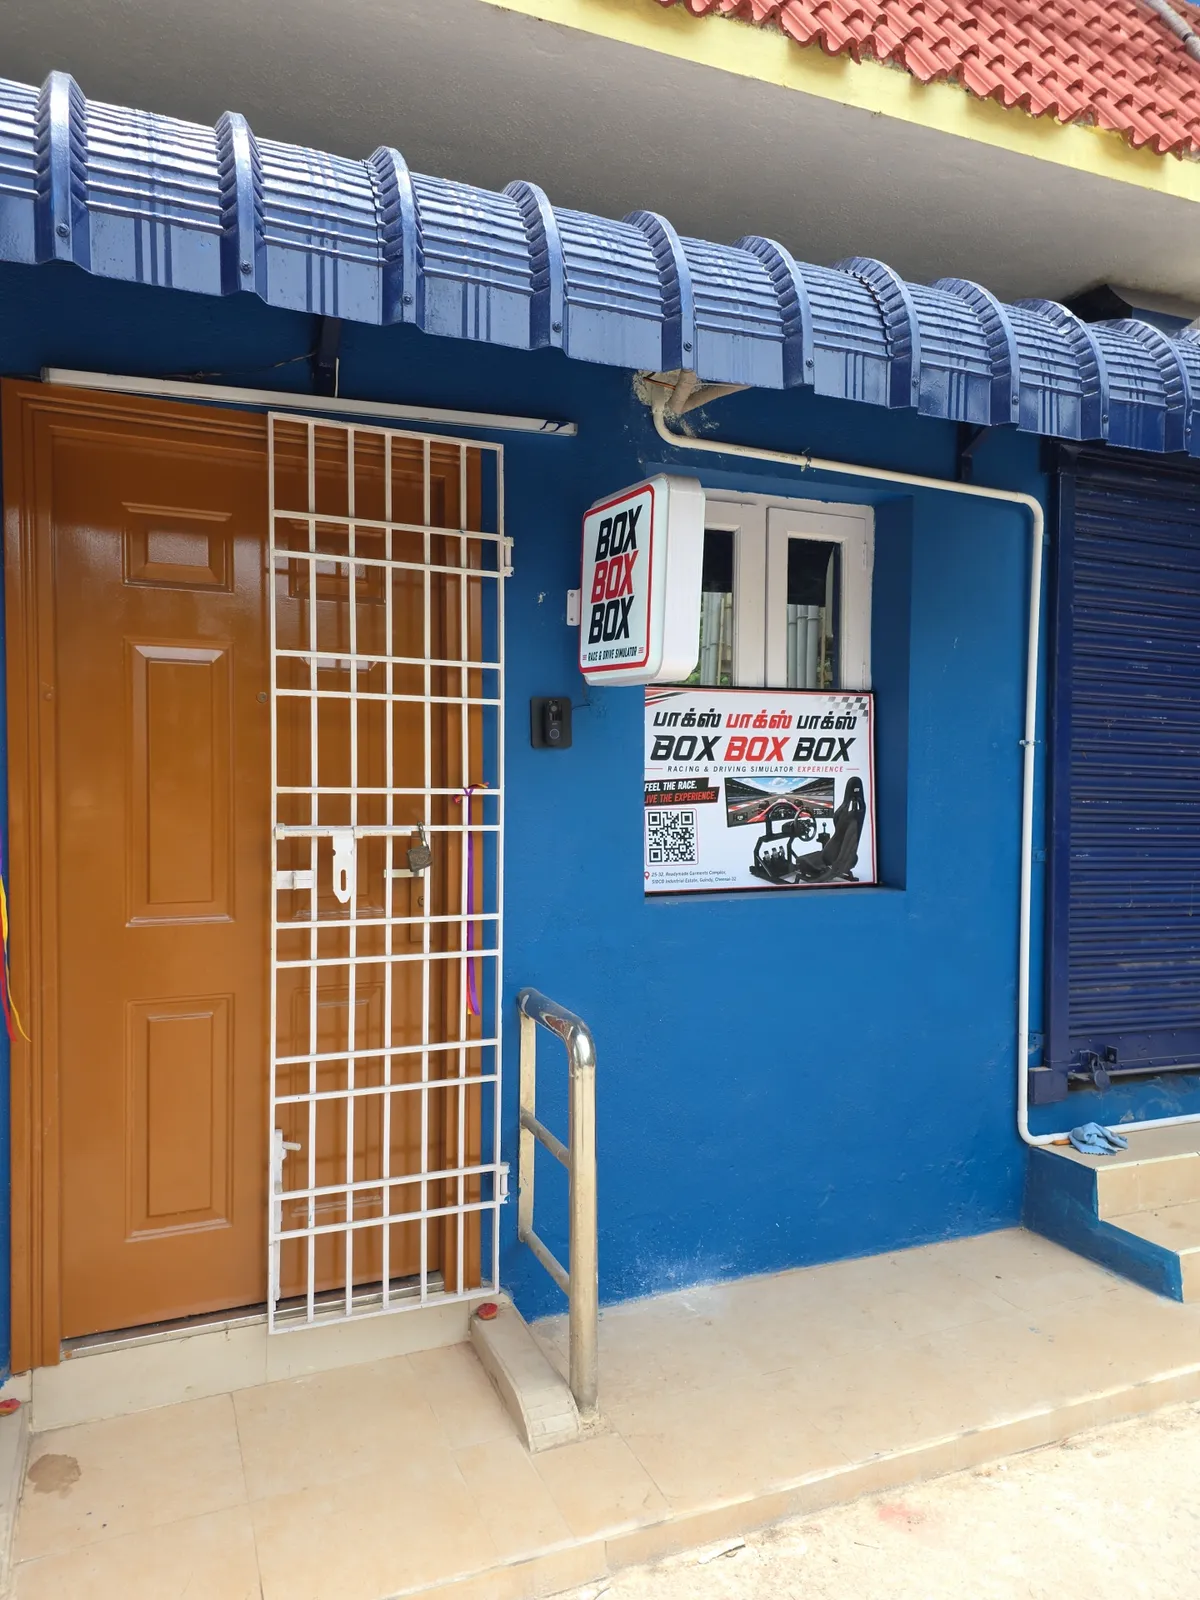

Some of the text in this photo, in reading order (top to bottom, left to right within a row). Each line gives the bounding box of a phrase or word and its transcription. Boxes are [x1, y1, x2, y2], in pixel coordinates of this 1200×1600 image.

[595, 504, 643, 562] BOX
[591, 550, 639, 604] BOX
[588, 596, 635, 644] BOX
[588, 651, 598, 661] RACE
[603, 649, 615, 660] DRIVE
[615, 646, 638, 658] SIMULATOR
[653, 708, 857, 730] பாக்ஸ் பாக்ஸ் பாக்ஸ்
[650, 735, 857, 762] BOX BOX BOX
[667, 765, 844, 773] RACING & DRIVING SIMULATOR EXPERIENCE
[644, 781, 697, 792] FEEL THE RACE.
[644, 791, 716, 803] IVE THE EXPERIENCE.
